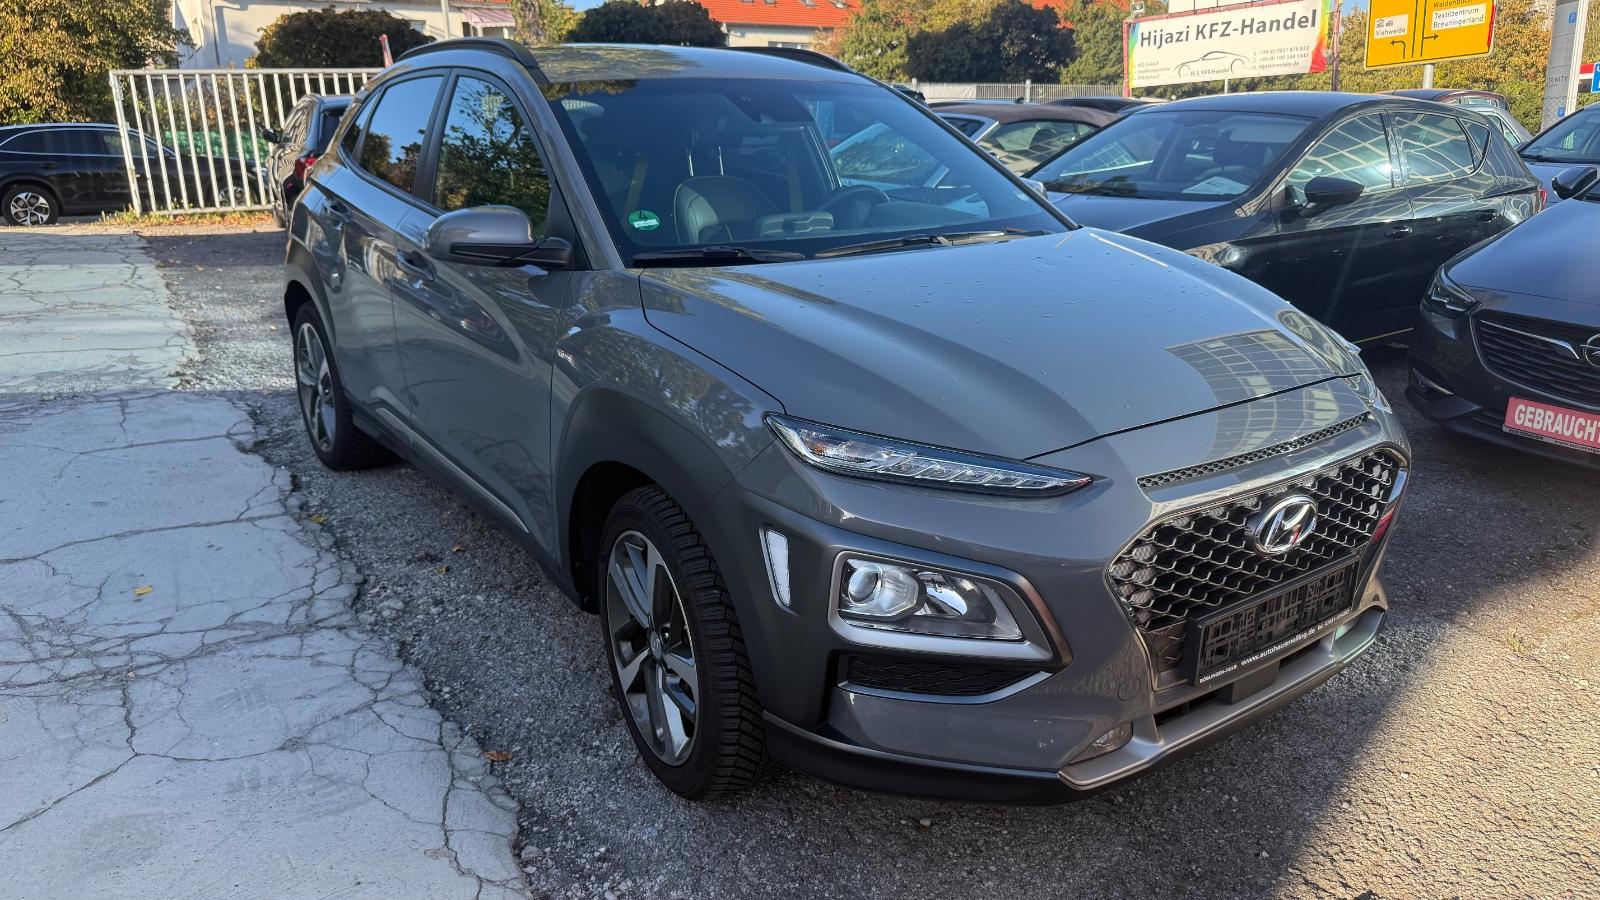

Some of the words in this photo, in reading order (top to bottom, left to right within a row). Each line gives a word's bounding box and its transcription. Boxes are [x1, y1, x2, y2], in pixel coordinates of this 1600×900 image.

[1435, 8, 1479, 19] Textilzentrum
[1140, 25, 1190, 49] Hijazi
[1195, 9, 1318, 41] KFZ-Handel
[1433, 14, 1484, 29] Breuningerland
[1376, 26, 1406, 37] Viehweide
[1514, 403, 1600, 444] GEBRAUCH
